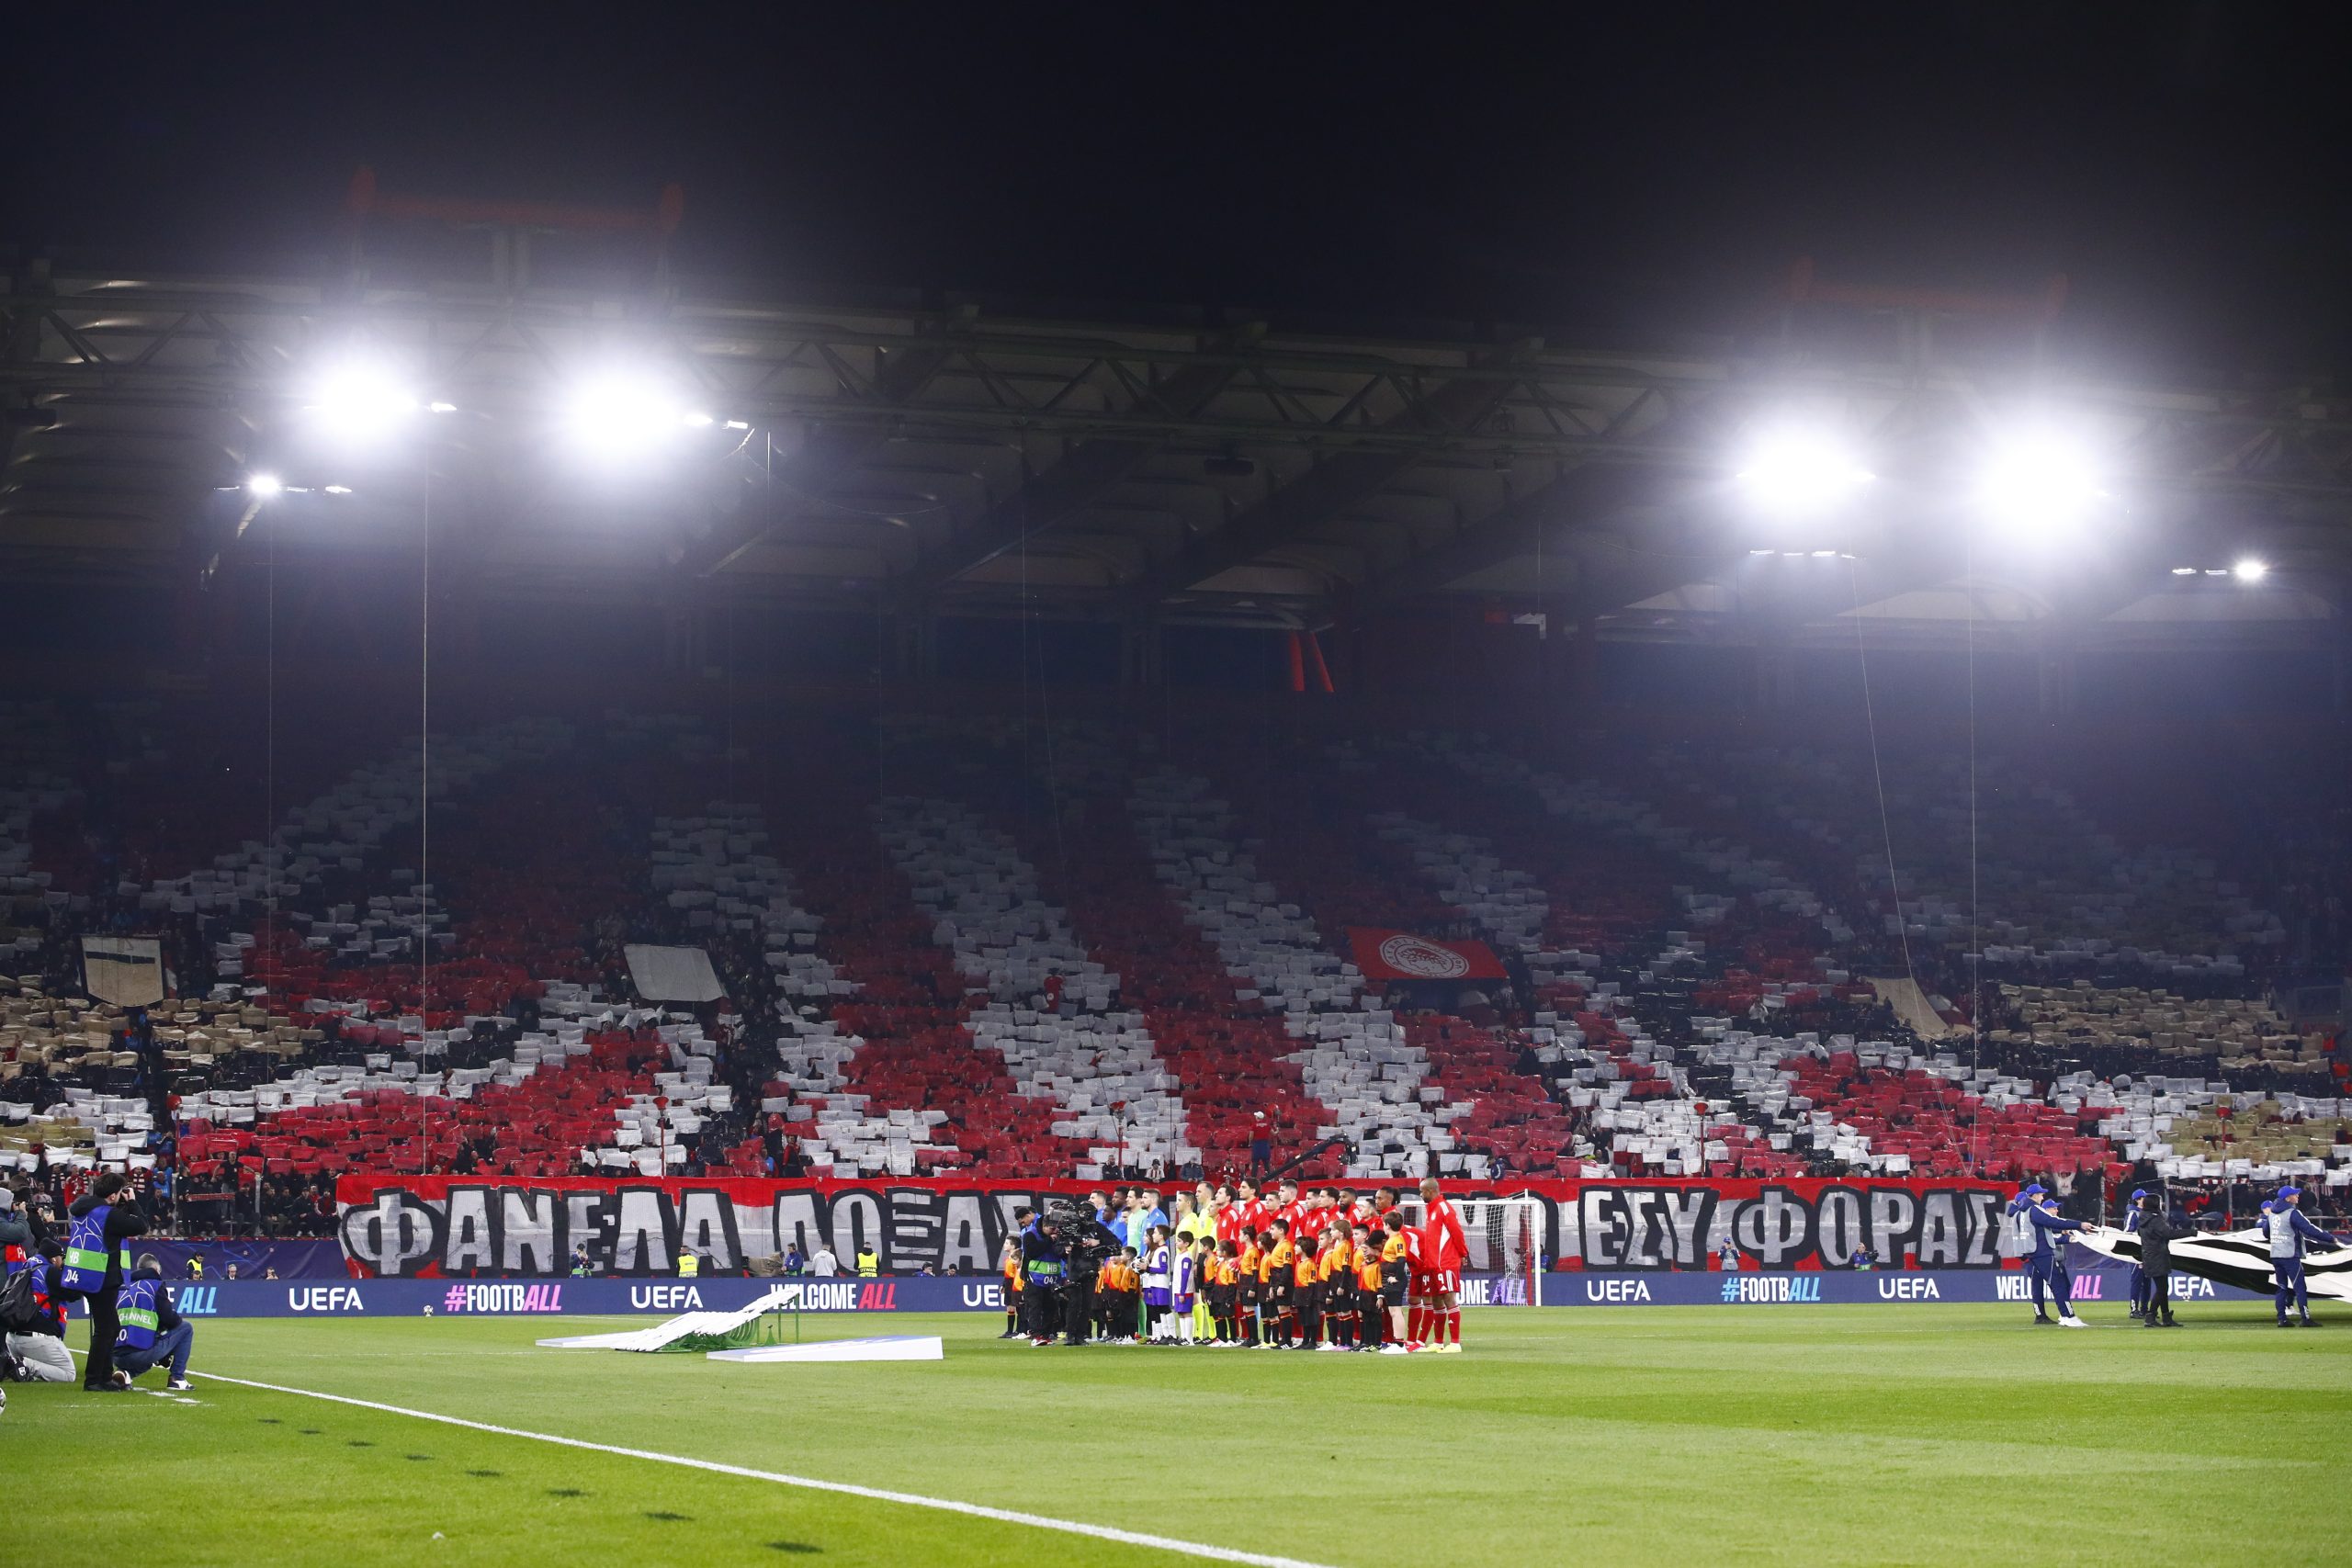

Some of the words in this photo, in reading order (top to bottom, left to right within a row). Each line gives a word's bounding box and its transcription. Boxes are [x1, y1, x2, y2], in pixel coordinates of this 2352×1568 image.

[344, 1188, 736, 1276] ΦΑΝΕΛΑ
[1582, 1188, 1707, 1269] ΕΣΥ
[1736, 1188, 1997, 1268] ΦΟΡΑΣ
[1047, 1264, 1058, 1273] HB
[1437, 1273, 1444, 1284] 9
[445, 1284, 561, 1312] #FOOTBALL
[631, 1286, 703, 1309] UEFA
[857, 1283, 897, 1310] ALL
[963, 1284, 1005, 1307] UE
[1588, 1280, 1651, 1301] UEFA
[1721, 1277, 1820, 1302] #FOOTBALL
[1879, 1278, 1940, 1299] UEFA
[2070, 1275, 2103, 1300] ALL
[177, 1287, 217, 1314] ALL
[289, 1288, 363, 1311] UEFA
